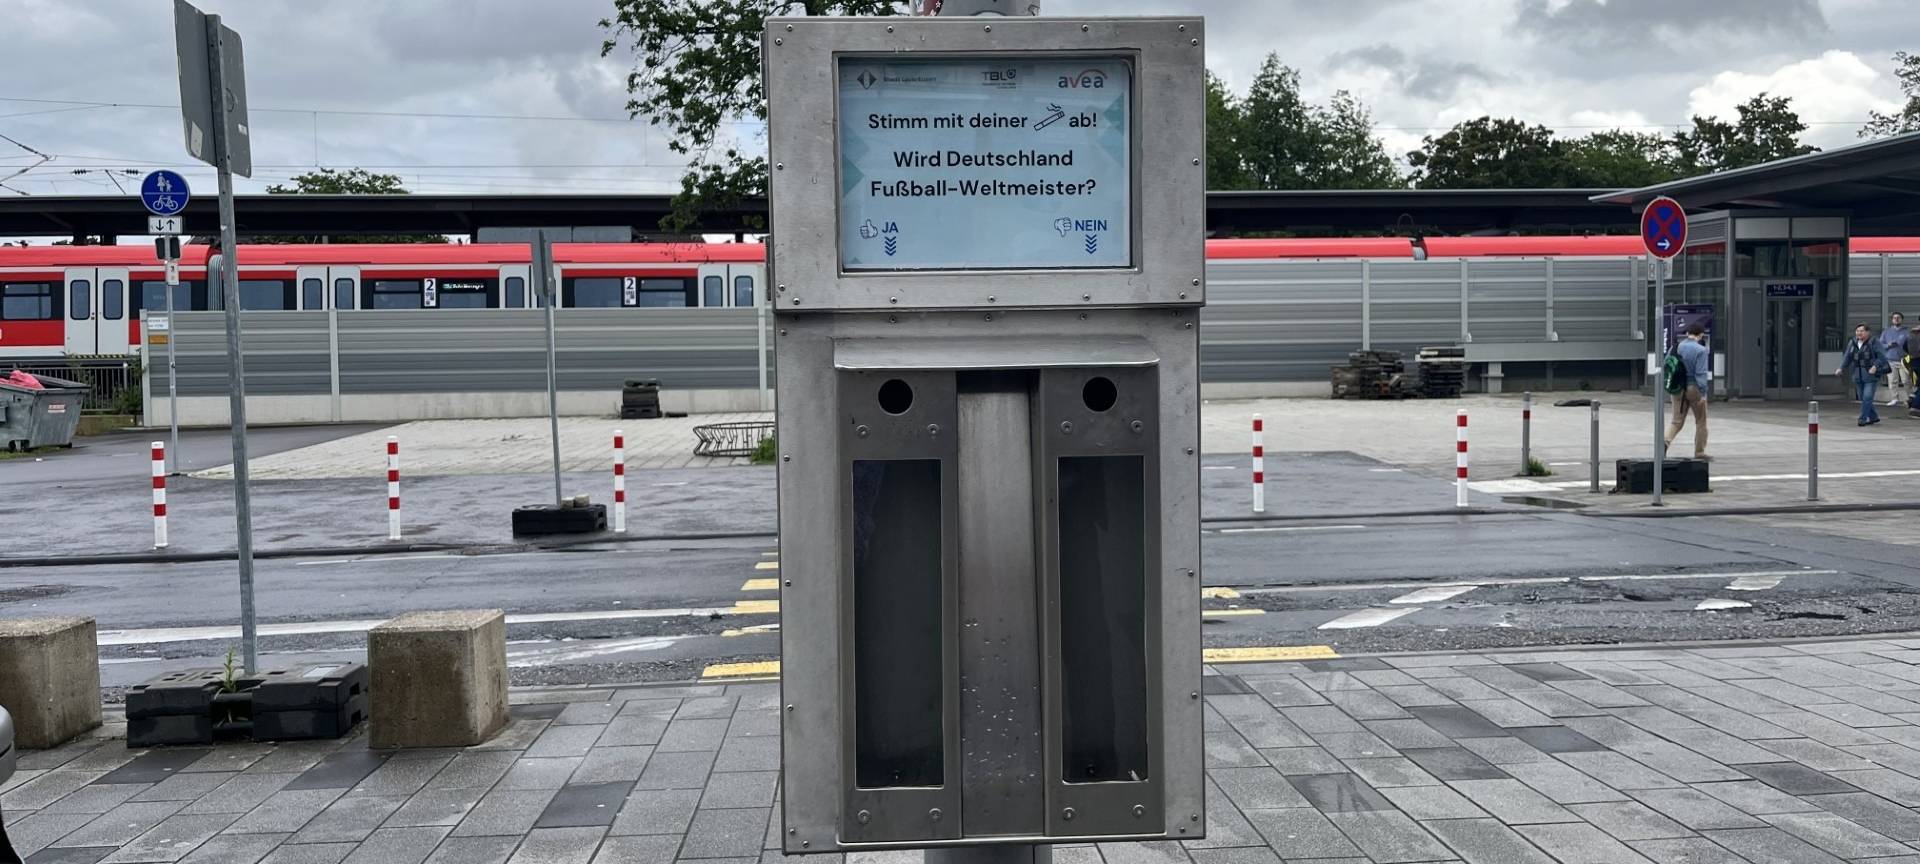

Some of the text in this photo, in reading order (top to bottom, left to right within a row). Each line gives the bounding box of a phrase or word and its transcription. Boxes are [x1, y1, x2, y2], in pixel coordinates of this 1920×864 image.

[1058, 75, 1104, 88] avea
[868, 112, 1097, 128] Stimm mit deiner ab!
[893, 149, 1073, 168] Wird Deutschland
[871, 179, 1097, 197] Fußball-Weltmeister?
[881, 221, 899, 233] JA
[1075, 219, 1107, 231] NEIN
[426, 279, 434, 291] 2
[626, 278, 634, 290] 2
